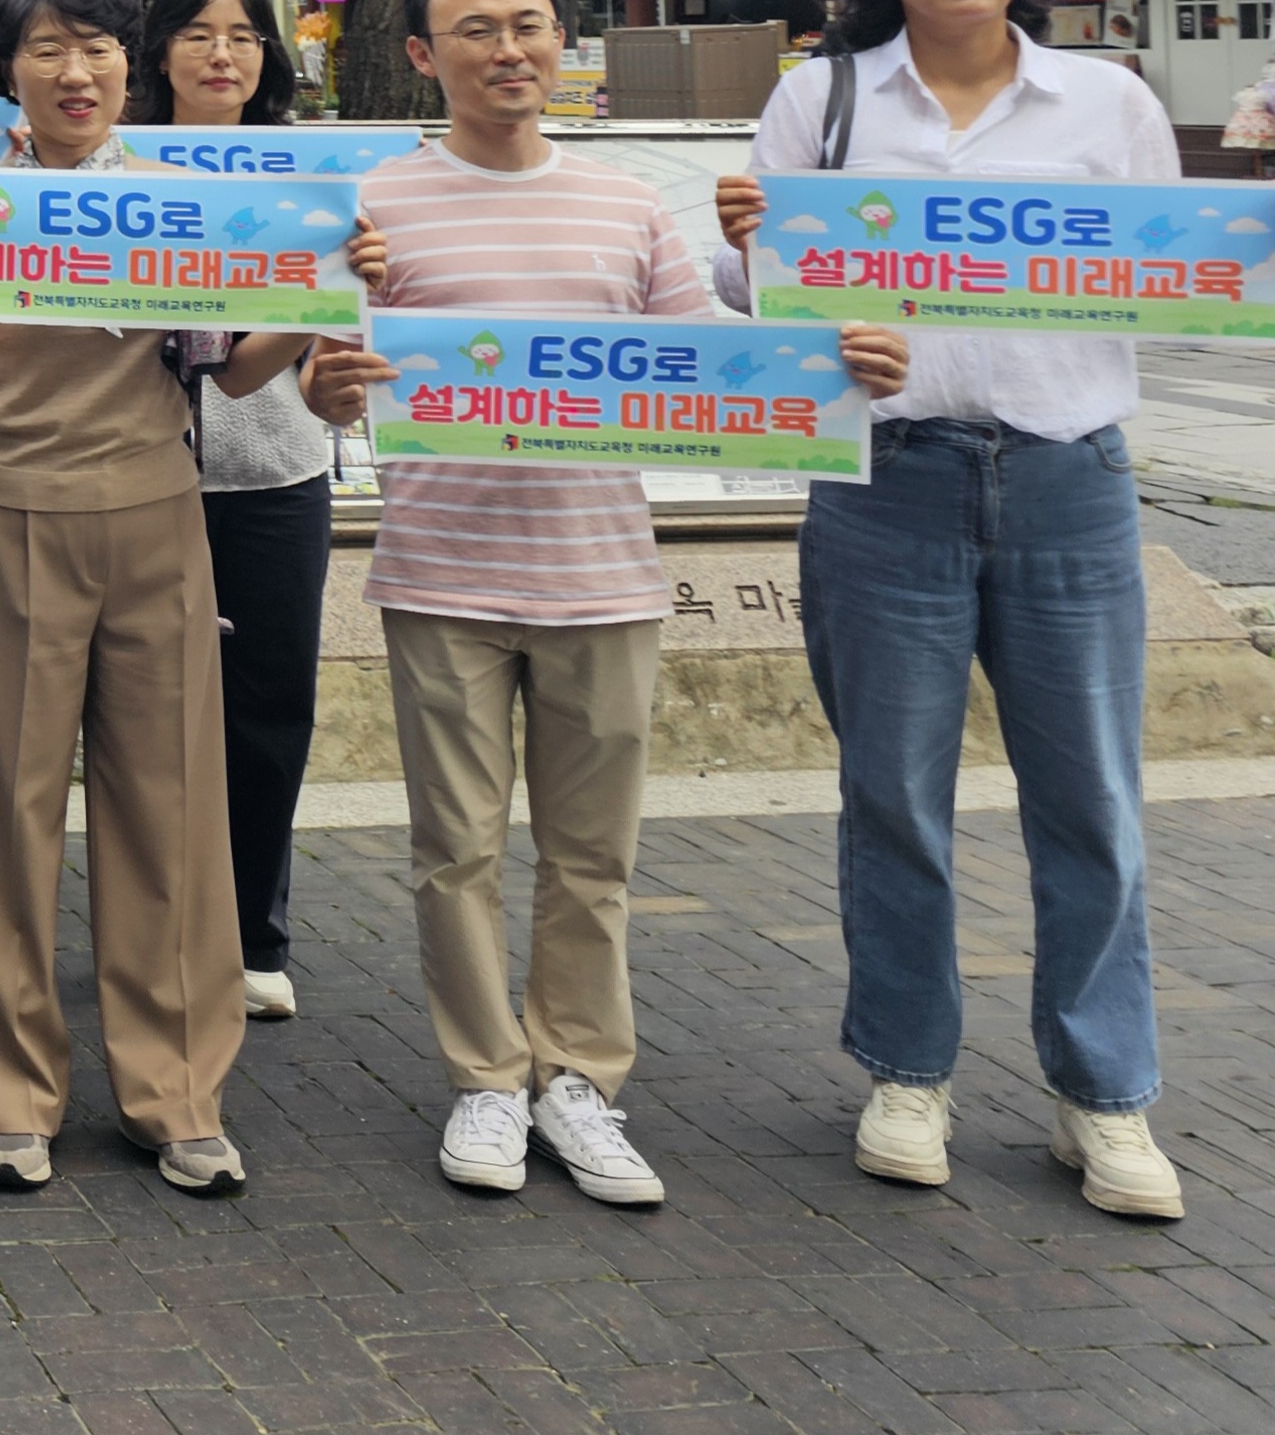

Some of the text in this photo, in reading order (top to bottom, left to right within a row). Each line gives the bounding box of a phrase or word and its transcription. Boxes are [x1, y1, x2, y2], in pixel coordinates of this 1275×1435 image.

[39, 190, 204, 239] ESG로
[924, 196, 1112, 247] ESG로
[130, 249, 316, 290] 미래교육
[798, 248, 1242, 302] 설계하는 미래교육
[33, 292, 226, 313] 전북특별자치도교육청 미래교육연구원
[919, 301, 1139, 323] 전북특별자치도교육청 미래교육연구원
[528, 336, 698, 383] ESG로
[410, 385, 816, 438] 설계하는 미래교육
[521, 436, 722, 457] 전북특별자치도교육청 미래교육연구원
